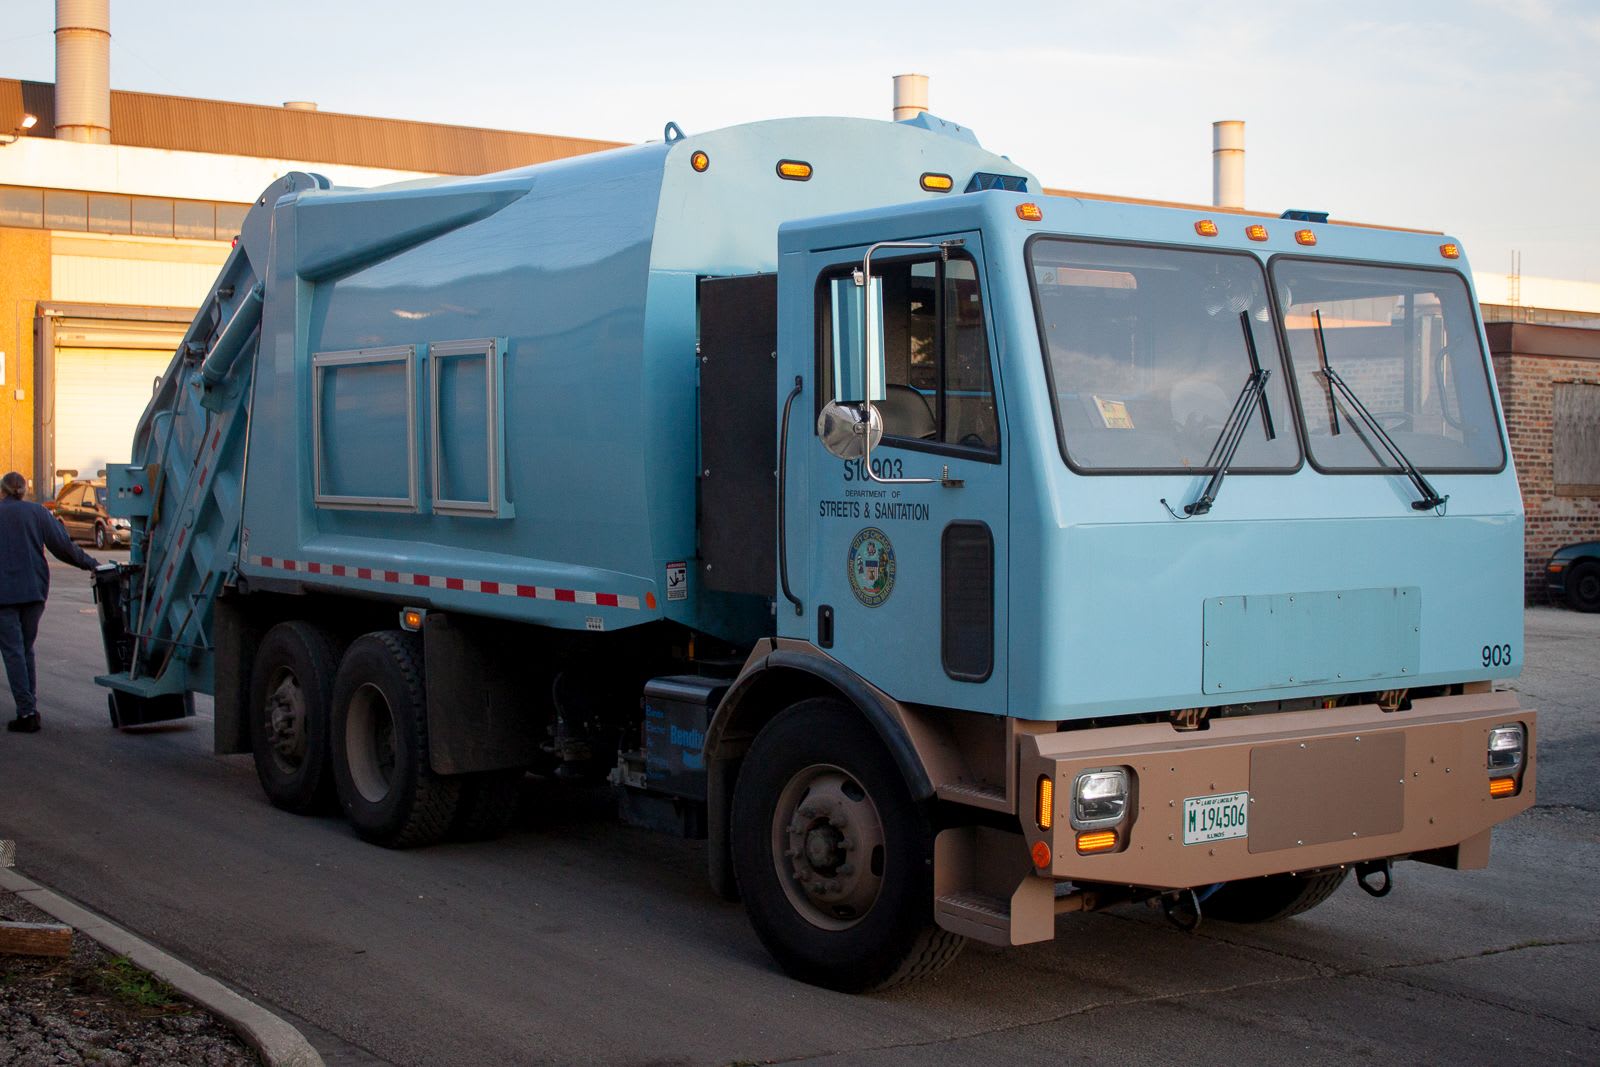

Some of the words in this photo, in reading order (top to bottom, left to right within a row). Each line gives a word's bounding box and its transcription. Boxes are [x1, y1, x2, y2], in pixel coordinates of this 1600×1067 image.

[844, 458, 903, 482] S10903
[845, 489, 886, 498] DEPARTMENT
[891, 490, 901, 498] OF
[819, 500, 860, 518] STREETS
[863, 504, 871, 519] &
[875, 503, 930, 521] SANITATION
[1482, 643, 1512, 668] 903
[1189, 809, 1196, 832] M
[1200, 803, 1245, 832] 194506
[1206, 831, 1225, 839] ILLINOIS
